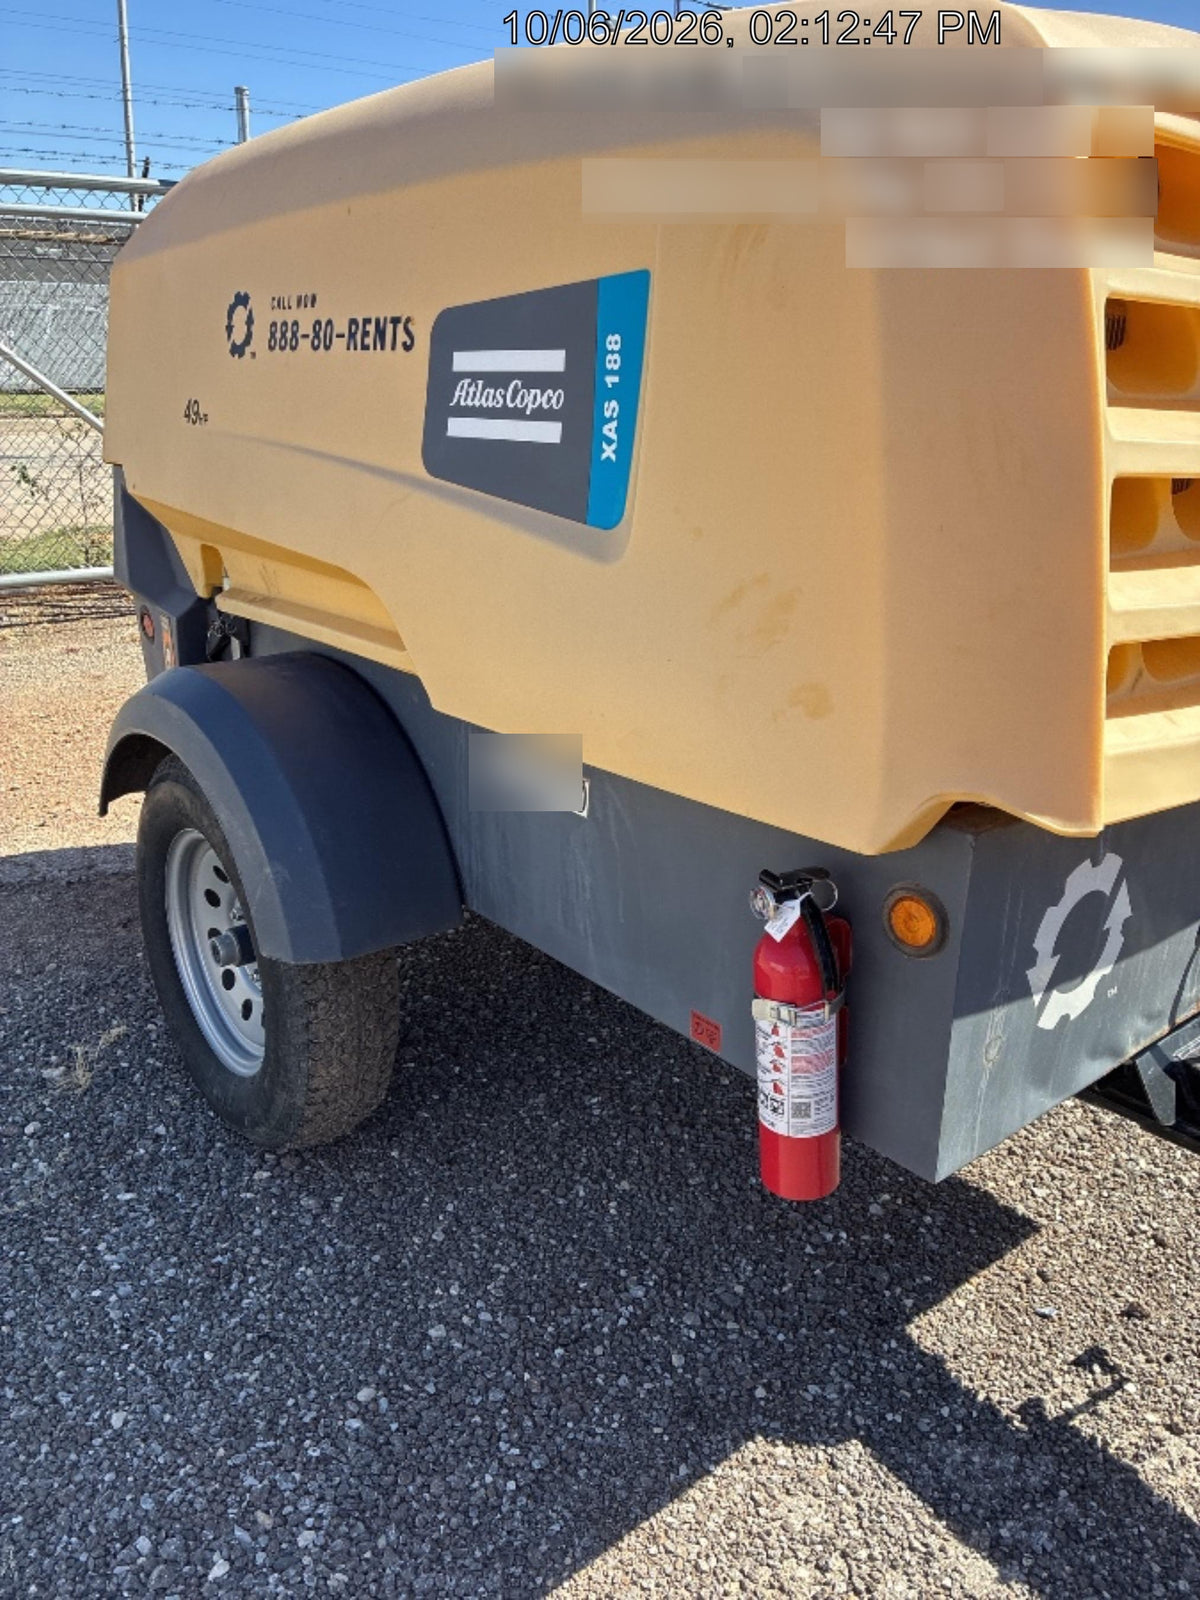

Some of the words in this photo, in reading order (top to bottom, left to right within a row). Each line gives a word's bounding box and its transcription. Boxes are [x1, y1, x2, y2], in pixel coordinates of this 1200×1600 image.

[271, 296, 292, 310] CALL
[268, 316, 415, 352] 888-80-RENTS
[604, 332, 622, 389] 188
[449, 378, 506, 407] Atlas
[506, 379, 564, 414] Copco
[600, 399, 621, 463] XAS
